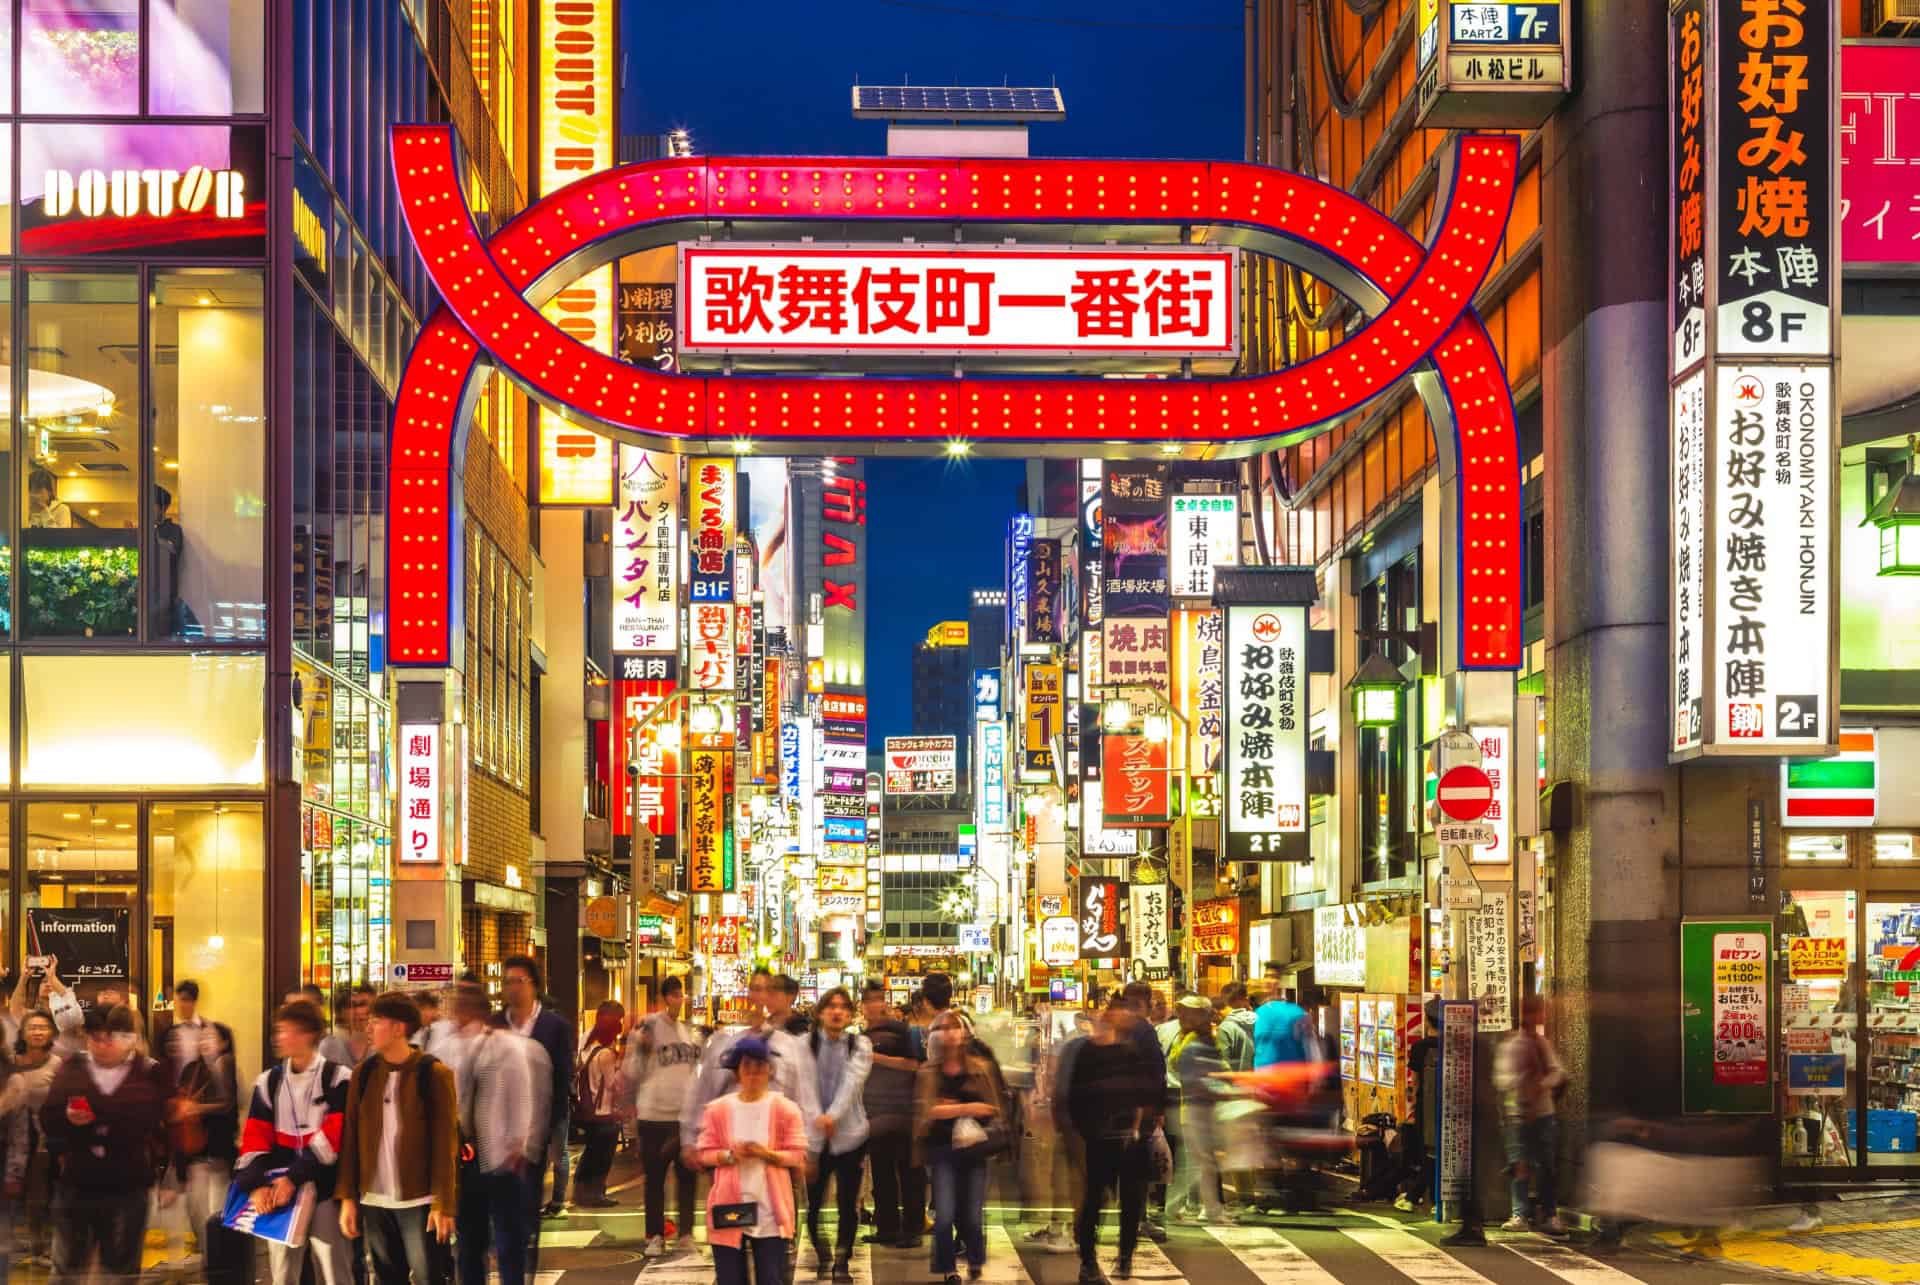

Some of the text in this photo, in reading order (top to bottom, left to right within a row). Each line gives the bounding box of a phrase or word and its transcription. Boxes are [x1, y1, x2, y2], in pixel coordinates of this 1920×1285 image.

[1461, 26, 1503, 38] PART2
[1515, 7, 1548, 39] 7F
[1466, 58, 1544, 80] 小松ビル
[1680, 11, 1703, 259] お好み焼
[1737, 0, 1810, 238] お好み焼
[44, 165, 246, 218] DOUTOR
[1728, 244, 1819, 289] 本陣
[705, 265, 1215, 337] 歌舞伎町一番街
[1742, 301, 1807, 342] 8F
[1683, 317, 1701, 358] 8F
[1776, 382, 1792, 486] 歌舞伎町名物
[699, 464, 725, 574] まぐろ商店
[1799, 382, 1815, 615] OKONOMIYAKI HONJIN
[620, 500, 652, 609] バンタイ
[656, 500, 671, 602] タイ国料理専門店
[1725, 408, 1767, 699] お好み焼き本陣
[693, 580, 730, 598] B1F
[632, 635, 657, 647] 3F
[623, 657, 668, 679] 焼肉
[1780, 701, 1817, 731] 2F
[701, 735, 723, 746] 4F
[409, 734, 431, 851] 劇場通り
[1123, 737, 1154, 812] ステップ
[1250, 833, 1282, 853] 2F
[1440, 828, 1492, 842] 自転車を除く
[1791, 938, 1845, 951] ATM
